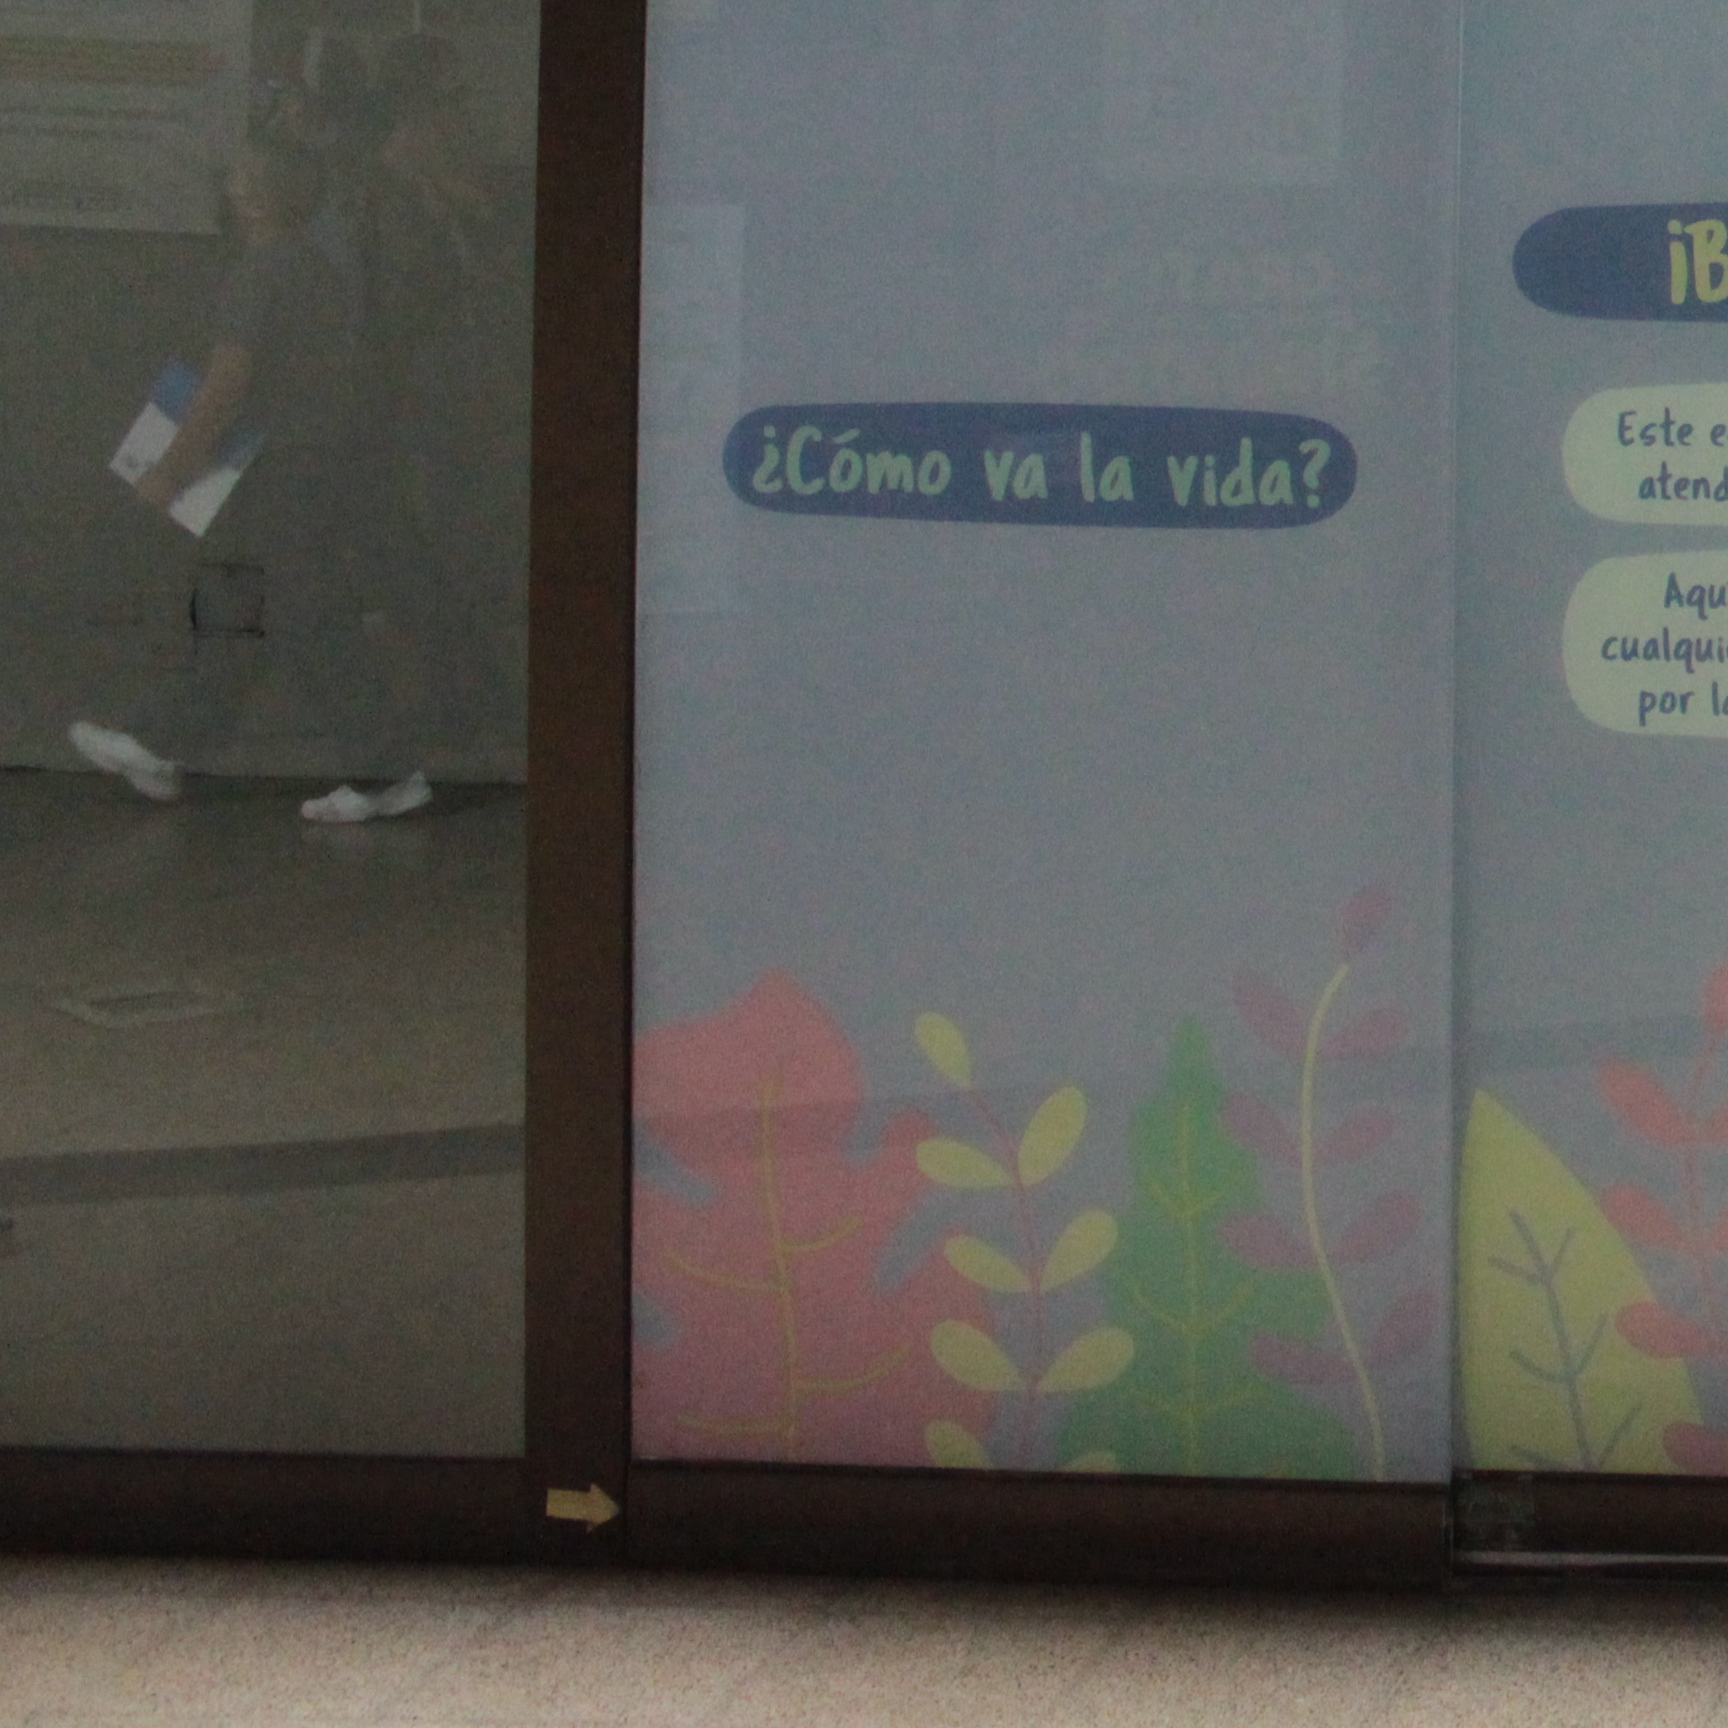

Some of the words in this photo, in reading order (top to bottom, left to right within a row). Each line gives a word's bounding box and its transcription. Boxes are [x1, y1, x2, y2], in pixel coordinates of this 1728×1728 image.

[1617, 406, 1694, 447] Este
[752, 425, 952, 495] ¿Cómo
[983, 448, 1048, 502] va
[1079, 431, 1134, 503] la
[1166, 436, 1331, 509] vida?
[1638, 690, 1696, 727] por
